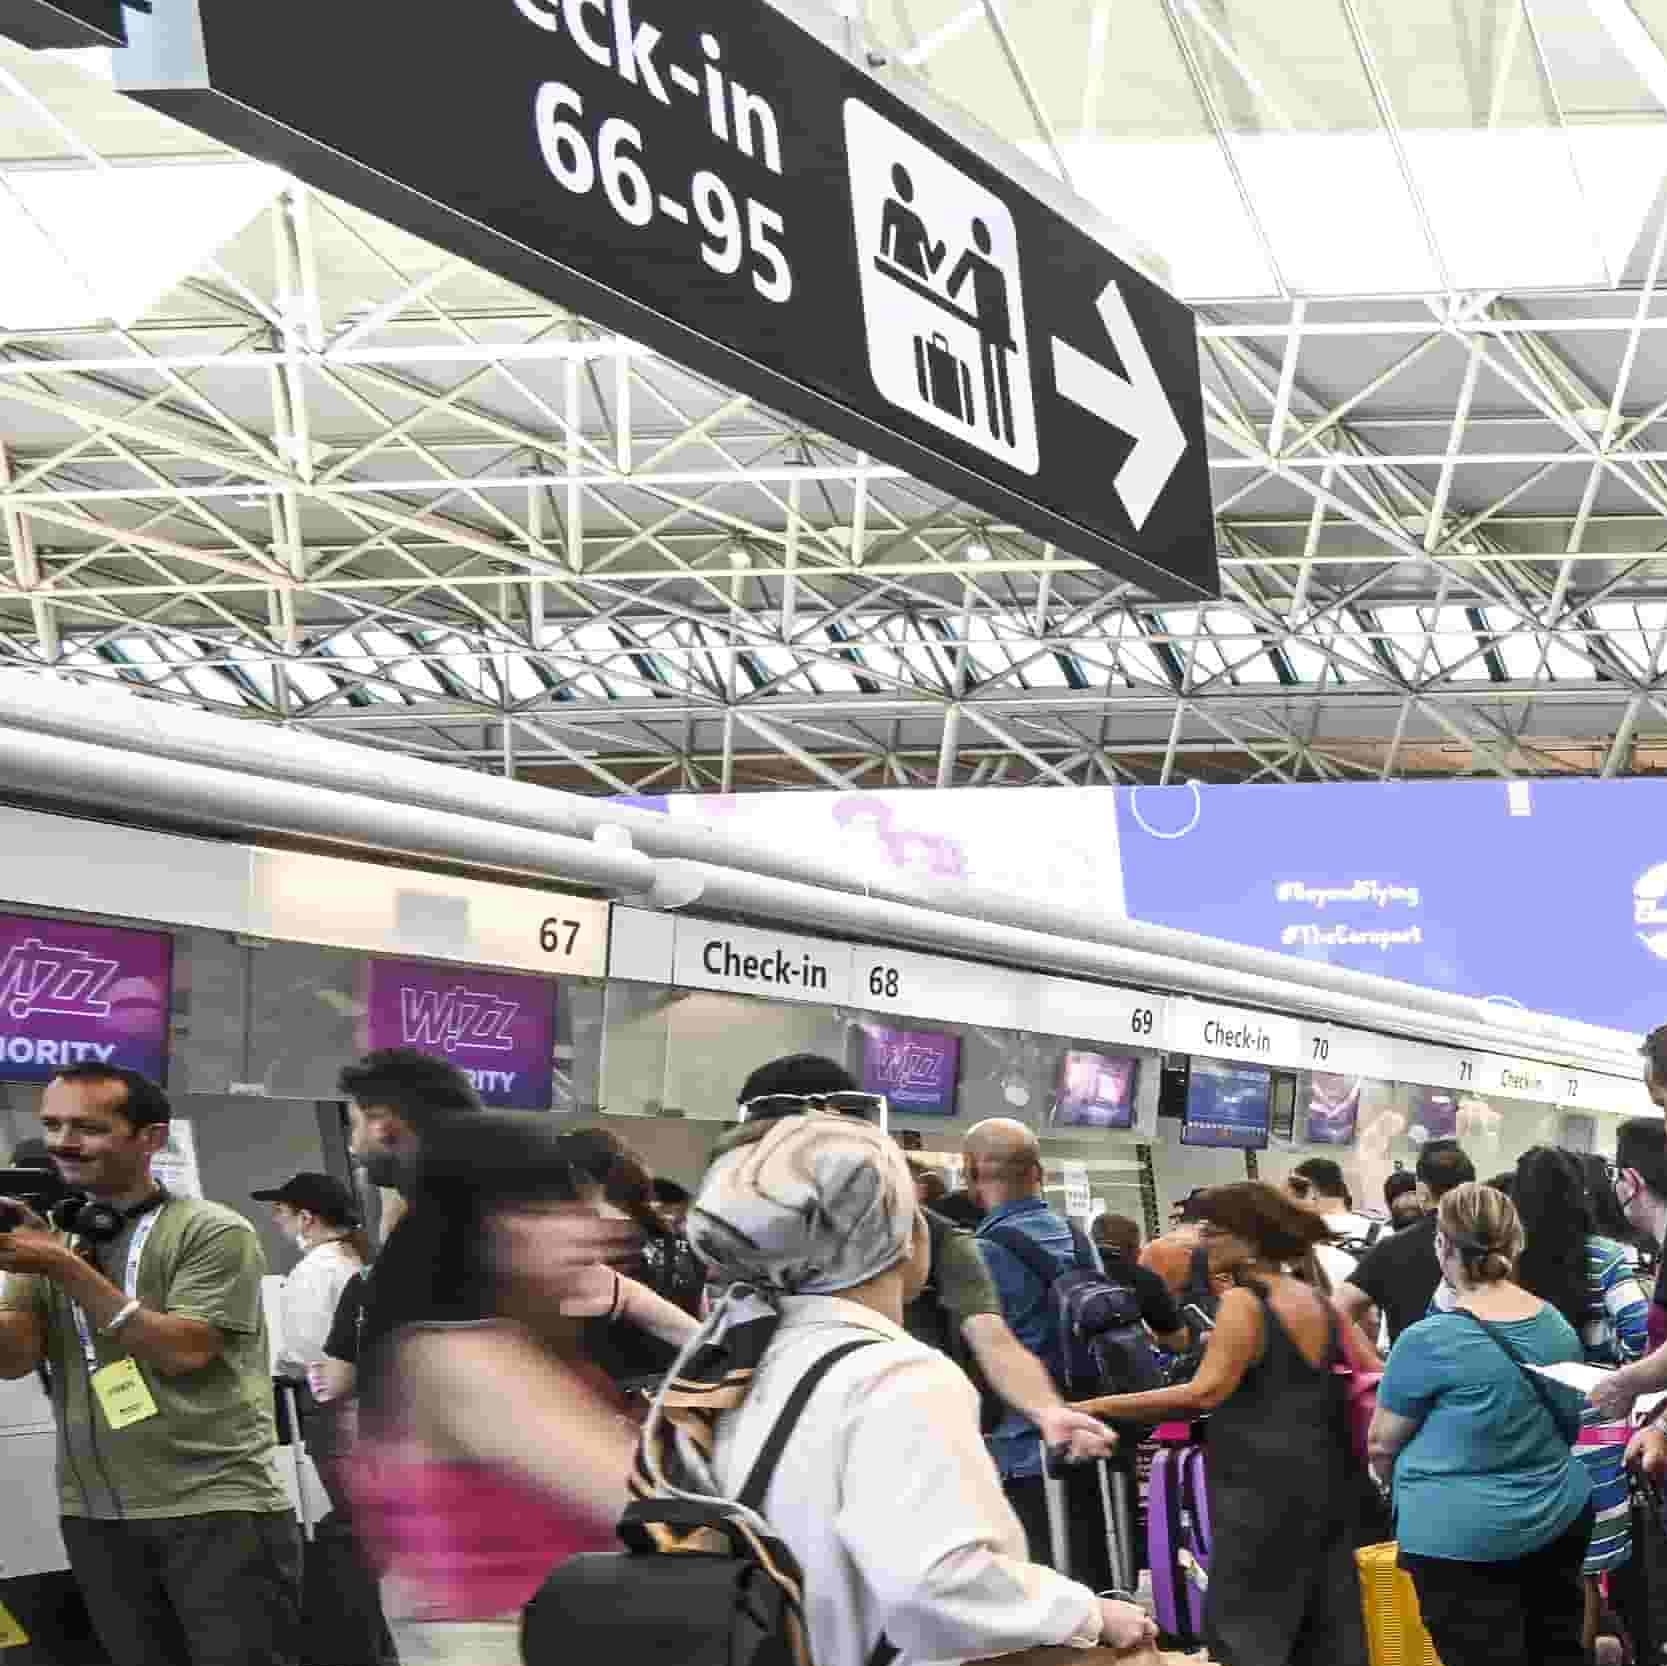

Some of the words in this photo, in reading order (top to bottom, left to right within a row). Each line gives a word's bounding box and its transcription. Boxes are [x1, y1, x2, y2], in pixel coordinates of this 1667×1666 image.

[514, 0, 783, 175] ck-in
[535, 81, 792, 302] 66-95
[540, 917, 581, 955] 67
[703, 940, 827, 989] Check-in
[869, 965, 899, 998] 68
[0, 1036, 117, 1065] IORITY
[1131, 1008, 1153, 1035] 69
[1204, 1020, 1271, 1052] Check-in
[1312, 1037, 1329, 1061] 70
